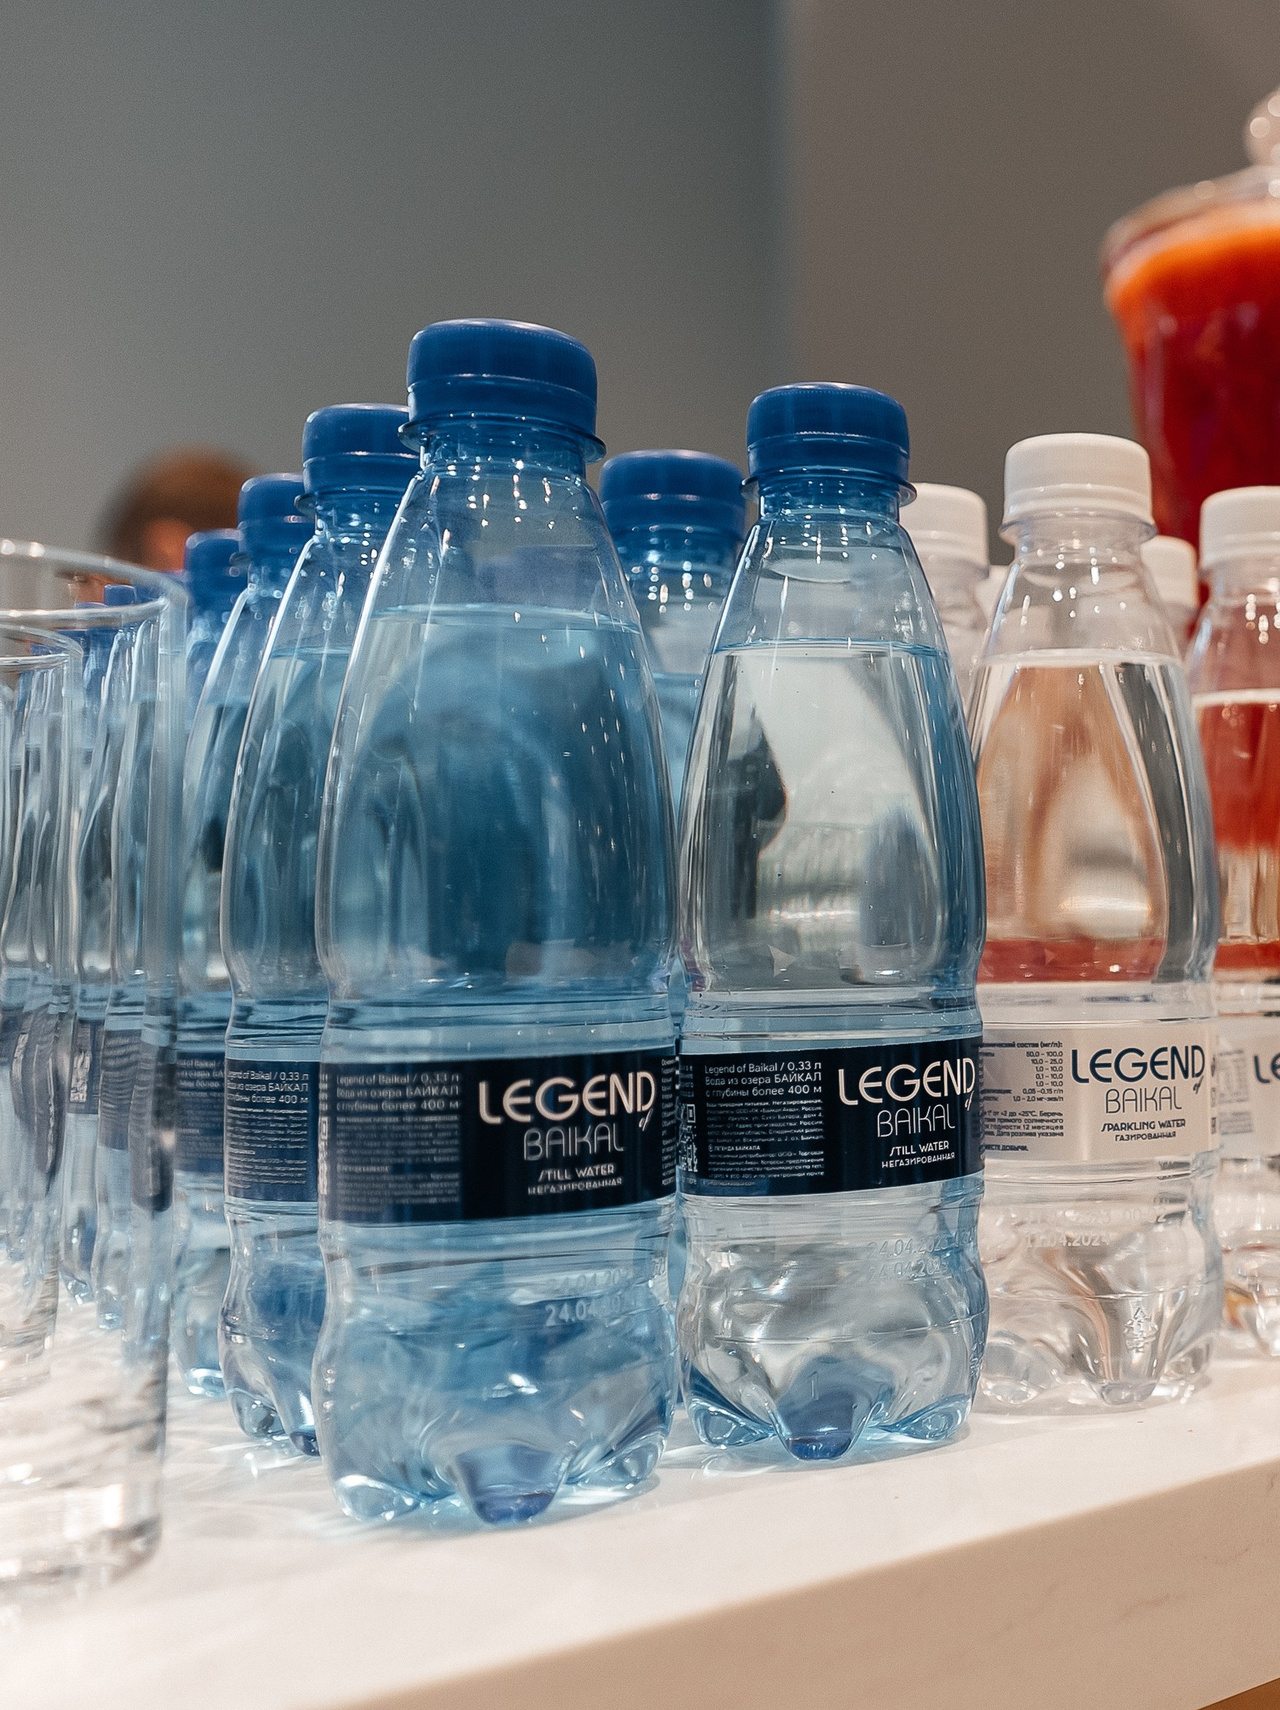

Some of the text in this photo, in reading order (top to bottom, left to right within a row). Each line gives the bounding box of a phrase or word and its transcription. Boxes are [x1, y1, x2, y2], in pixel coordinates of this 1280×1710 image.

[705, 1060, 822, 1076] Legend of Baikal / 0.33 л
[1071, 1044, 1206, 1084] LEGEND
[268, 1081, 309, 1092] БАЙКАЛ
[378, 1073, 410, 1085] Baikal
[705, 1071, 822, 1087] Вода из озера БАЙКАЛ
[838, 1057, 976, 1106] LEGEND
[279, 1095, 298, 1104] 400
[478, 1071, 656, 1125] LEGEND
[712, 1088, 749, 1099] глубины
[752, 1085, 785, 1097] более
[788, 1084, 810, 1094] 400
[1105, 1086, 1183, 1114] BAIKAL
[421, 1099, 445, 1110] 400
[449, 1101, 459, 1109] м
[877, 1103, 956, 1138] BAIKAL
[1101, 1118, 1186, 1133] SPARKLING WATER
[523, 1122, 624, 1161] BAIKAL
[1114, 1131, 1177, 1142] ГАЗИРОВАННАЯ
[889, 1140, 949, 1157] STILL WATER
[881, 1151, 956, 1168] НЕГАЗИРОВАННАЯ
[538, 1163, 615, 1182] STILL WATER
[528, 1177, 622, 1195] НЕГАЗИРОВАННАЯ
